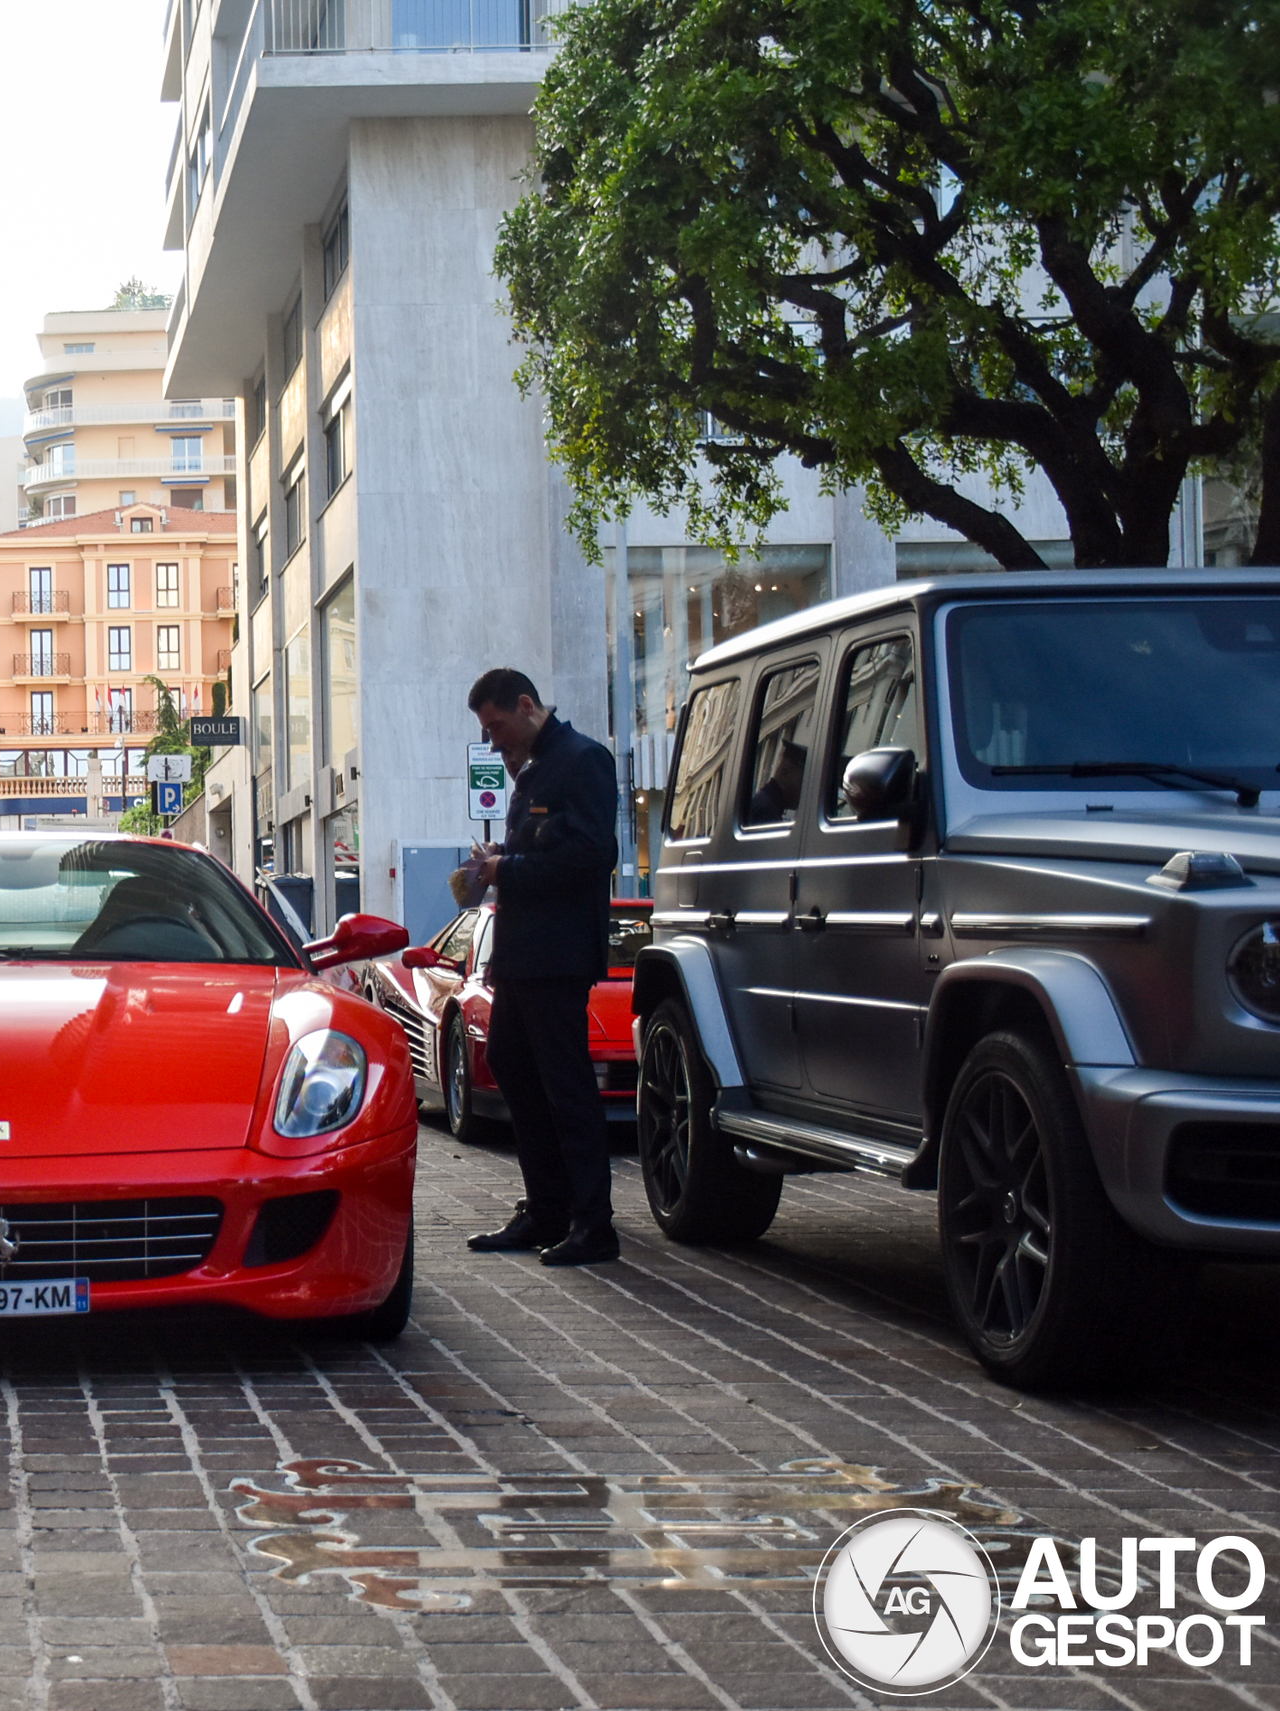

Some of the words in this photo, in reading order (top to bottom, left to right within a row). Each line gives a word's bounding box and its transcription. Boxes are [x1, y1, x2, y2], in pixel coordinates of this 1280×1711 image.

[193, 722, 238, 735] BOULE
[164, 787, 176, 808] P
[77, 1301, 86, 1309] 11
